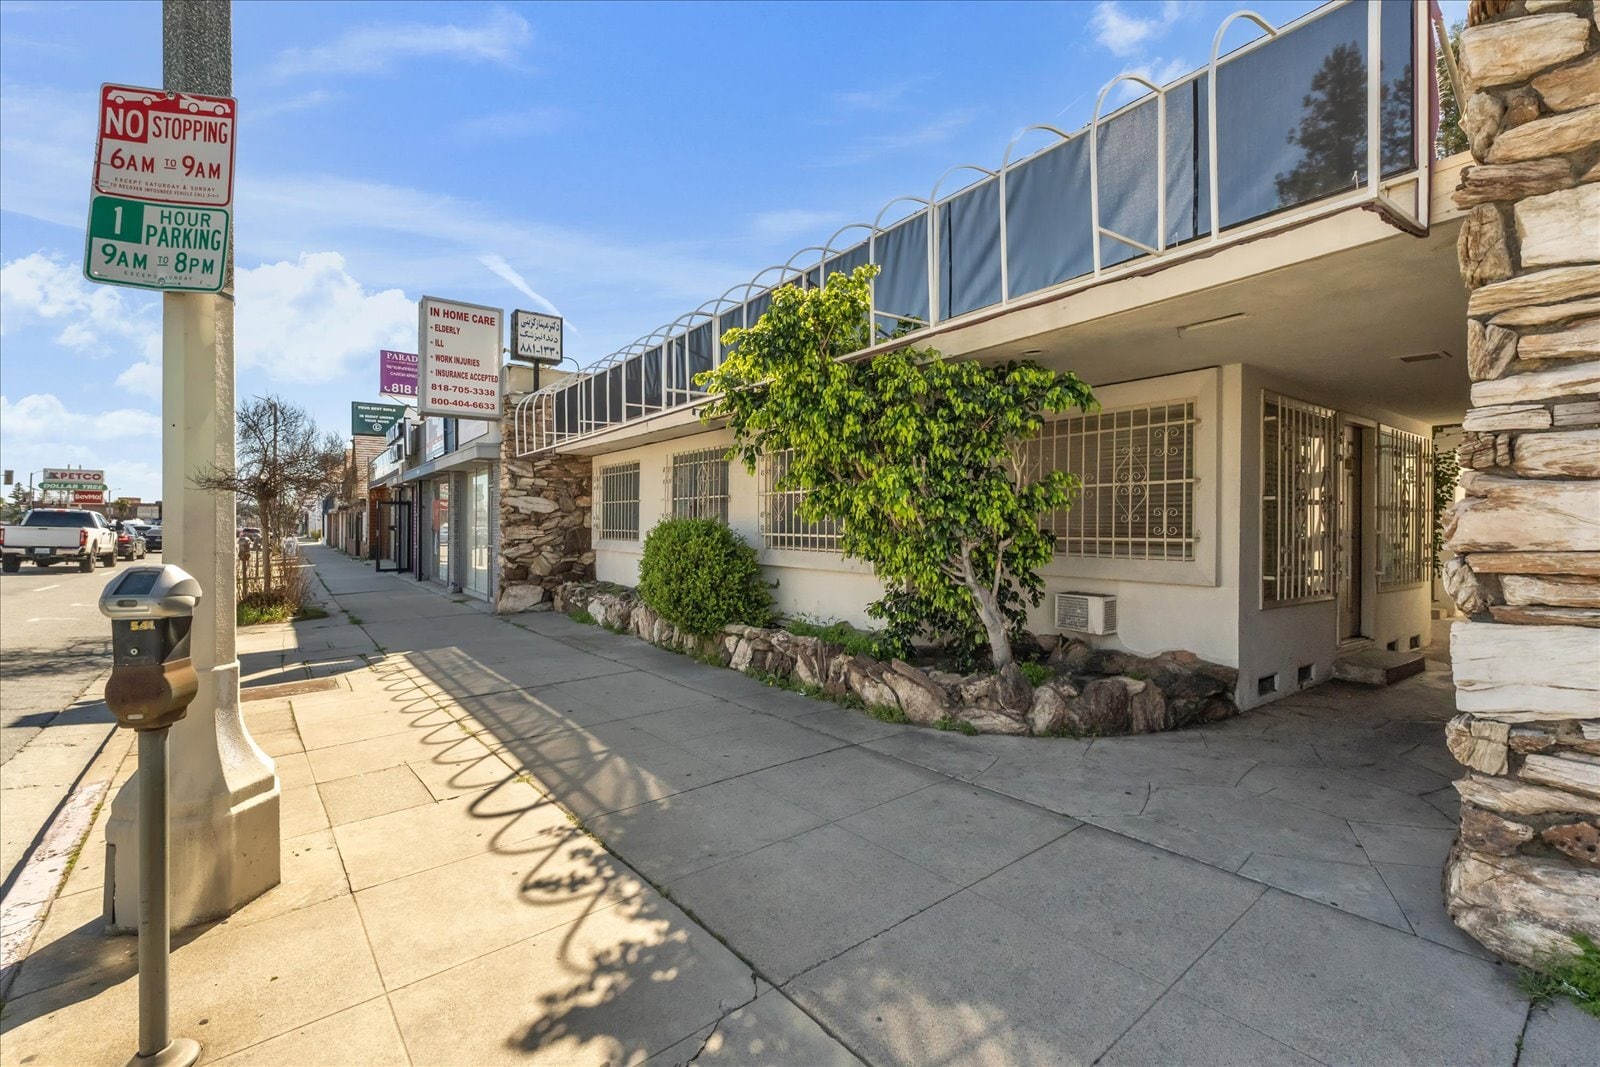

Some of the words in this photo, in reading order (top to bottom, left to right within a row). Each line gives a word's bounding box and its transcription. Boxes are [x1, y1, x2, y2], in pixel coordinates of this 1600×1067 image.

[105, 107, 144, 138] NO
[152, 115, 228, 144] STOPPING
[110, 148, 155, 174] 6AM
[164, 158, 177, 169] TO
[182, 155, 221, 179] 9AM
[114, 177, 141, 185] EXCEPT
[145, 181, 179, 190] SATURDAY
[144, 187, 172, 195] IMPOUNDED
[114, 206, 123, 235] 1
[160, 210, 211, 227] HOUR
[145, 224, 221, 251] PARKING
[101, 243, 147, 270] 9AM
[157, 256, 169, 266] TO
[174, 252, 215, 275] 8PM
[124, 270, 157, 279] EXCEPT
[430, 307, 440, 317] IN
[443, 309, 470, 322] HOME
[472, 314, 496, 326] CARE
[435, 323, 461, 335] ELDERLY
[435, 339, 444, 347] ILL
[386, 352, 418, 362] PARAD
[435, 354, 453, 364] WORK
[454, 356, 480, 367] INJURIES
[435, 368, 469, 380] INSURANCE
[470, 373, 499, 383] ACCEPTED
[391, 383, 412, 394] 818
[431, 383, 495, 397] 818-705-3338
[431, 397, 495, 410] 800-404-6633
[60, 472, 101, 480] PETCO
